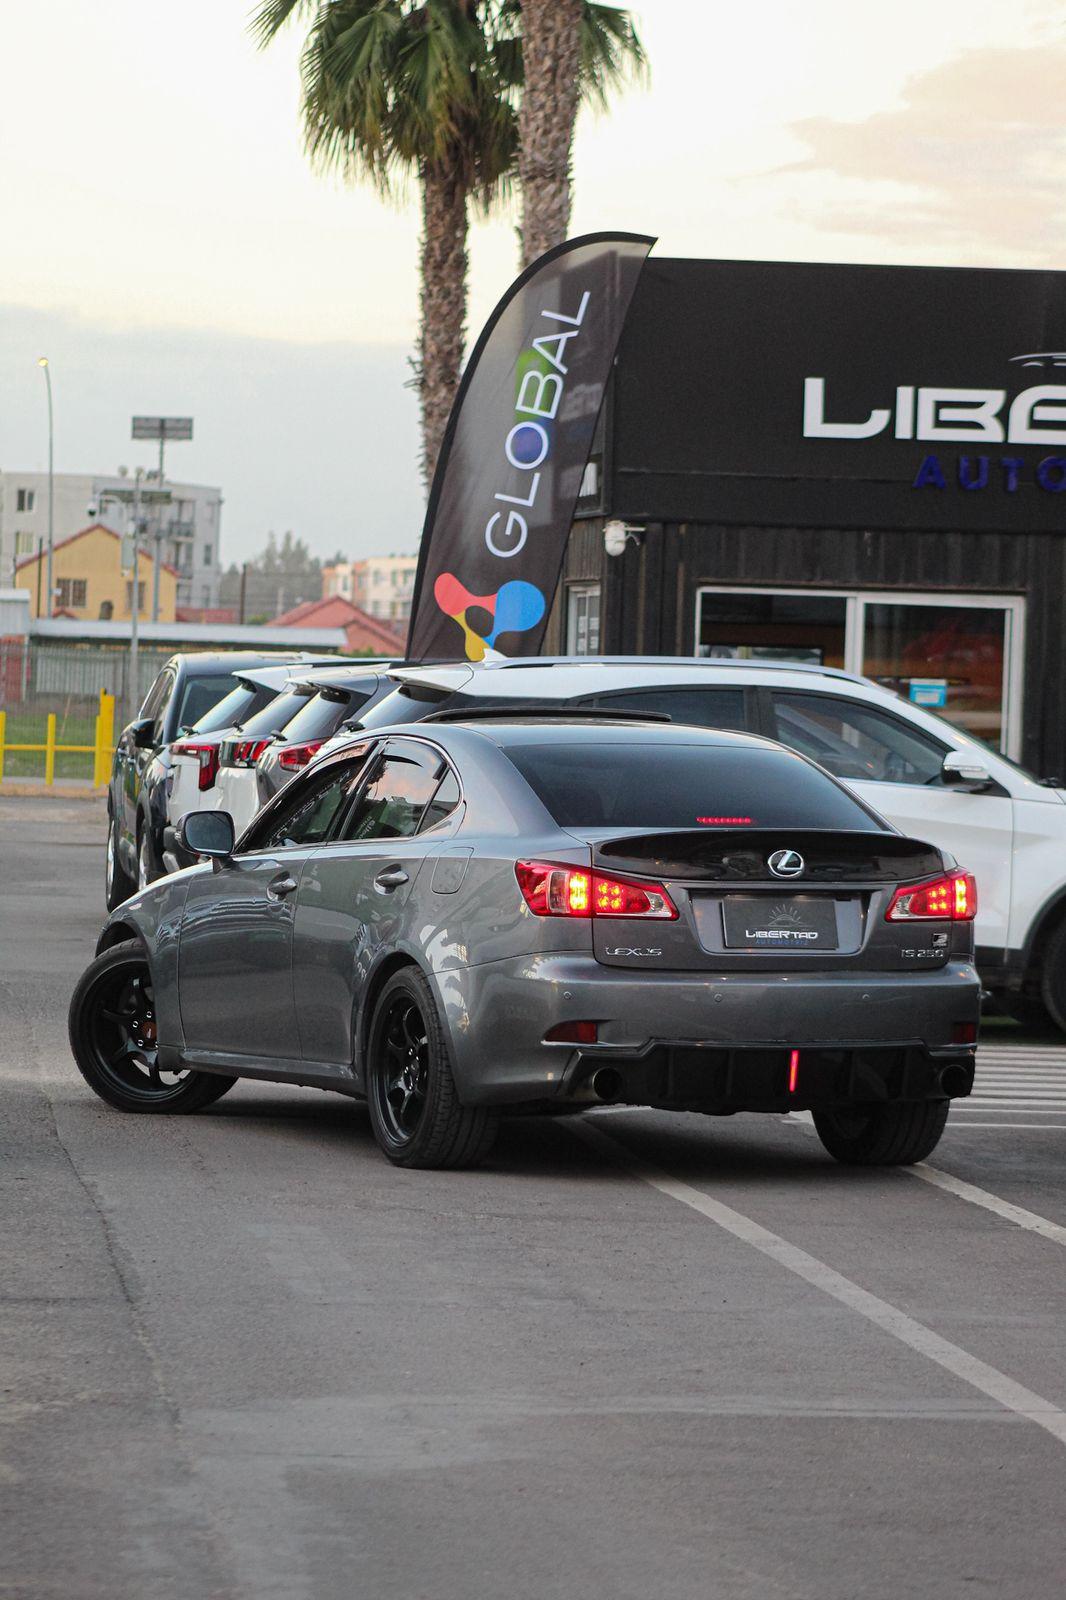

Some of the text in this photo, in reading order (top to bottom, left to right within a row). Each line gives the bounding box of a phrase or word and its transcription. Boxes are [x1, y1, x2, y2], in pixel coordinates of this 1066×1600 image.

[485, 290, 592, 559] GLOBAL
[912, 455, 1066, 493] AUTO
[745, 929, 818, 939] LIBERTAD
[605, 946, 662, 957] LEXUS
[901, 949, 944, 958] IS 250
